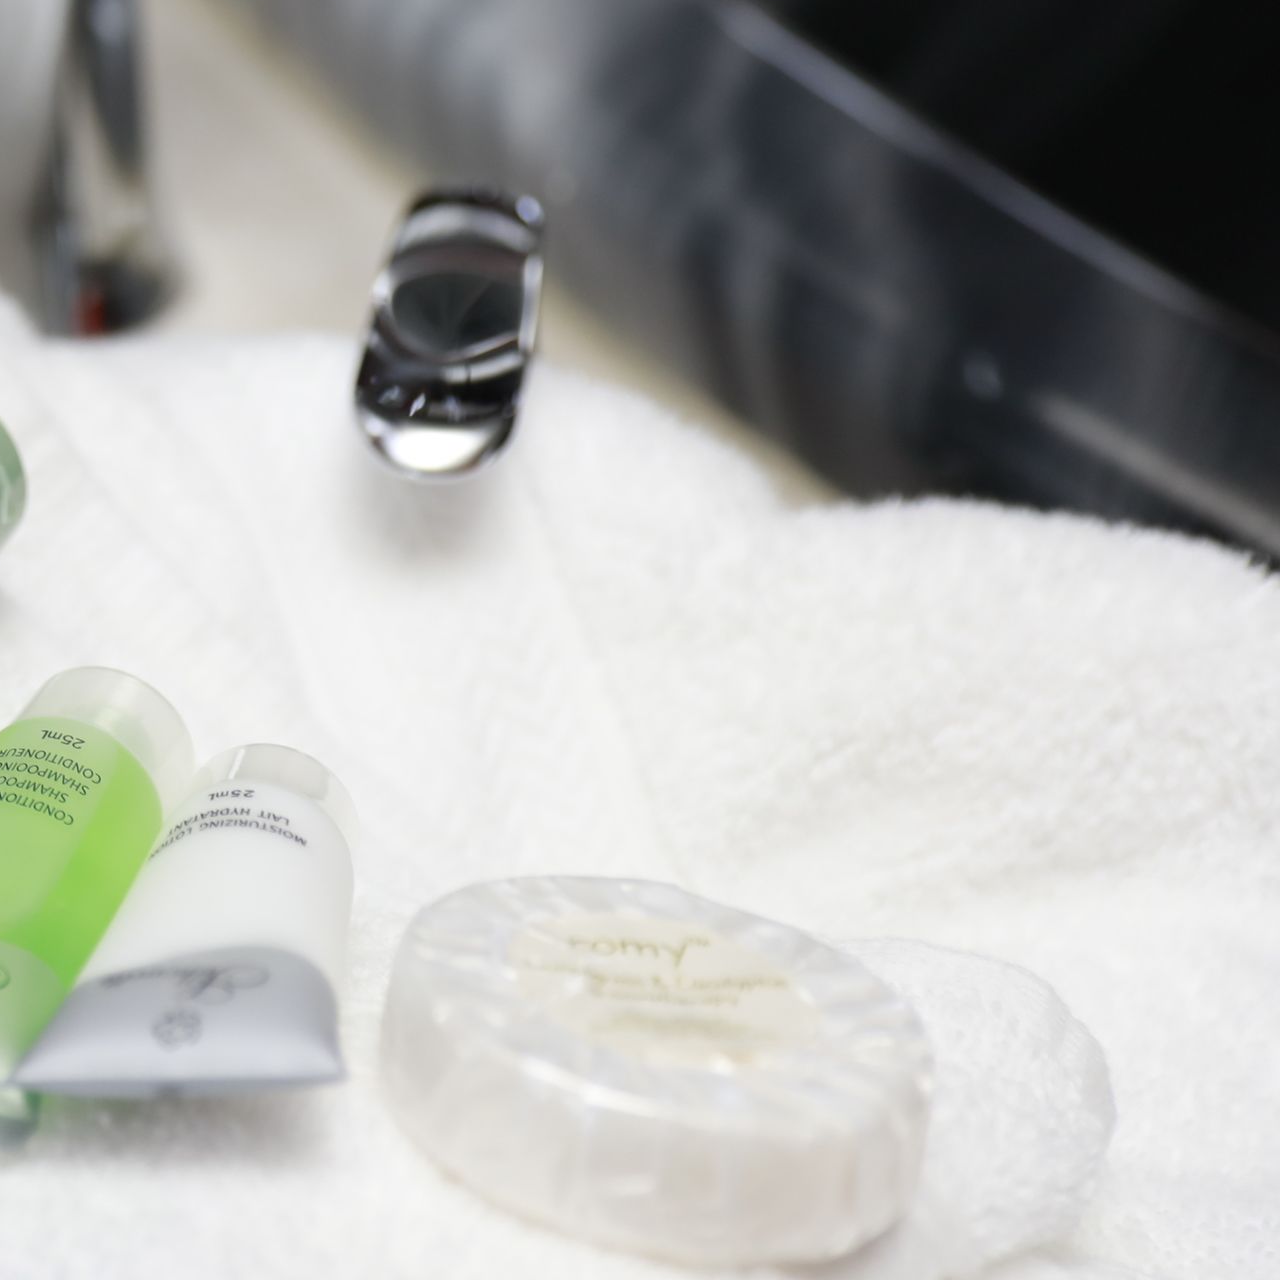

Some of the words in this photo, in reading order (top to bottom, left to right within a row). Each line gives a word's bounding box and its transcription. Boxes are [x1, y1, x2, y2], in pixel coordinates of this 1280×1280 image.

[41, 729, 85, 750] 25mL
[208, 789, 255, 801] 25mL
[167, 807, 251, 837] HYDRATANT
[258, 810, 290, 826] LAIT
[199, 819, 308, 847] MOISTURIZING
